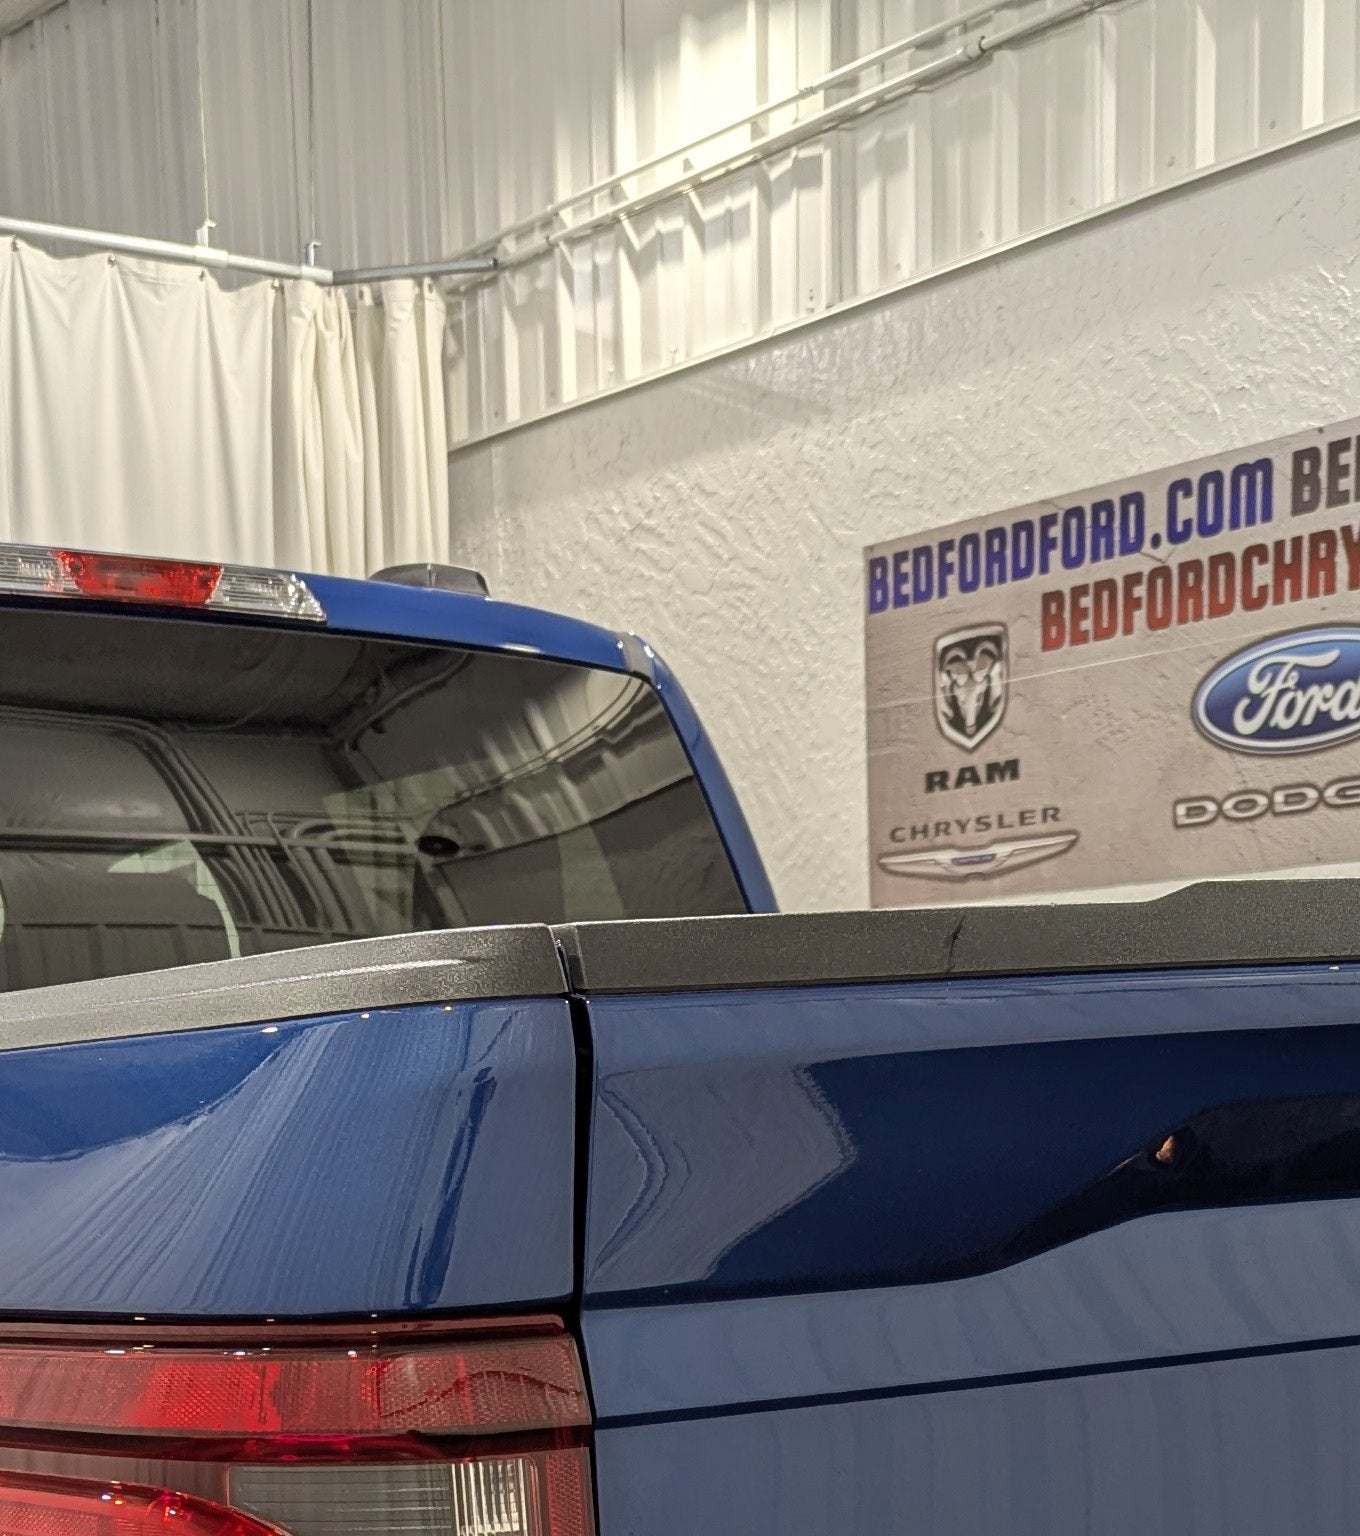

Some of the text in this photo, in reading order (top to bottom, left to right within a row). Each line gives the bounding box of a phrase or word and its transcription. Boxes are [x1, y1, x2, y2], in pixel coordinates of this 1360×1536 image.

[869, 457, 1274, 614] BEDFORDFORD.COM
[924, 758, 1021, 794] RAM
[889, 806, 1061, 844] CHRYSLER
